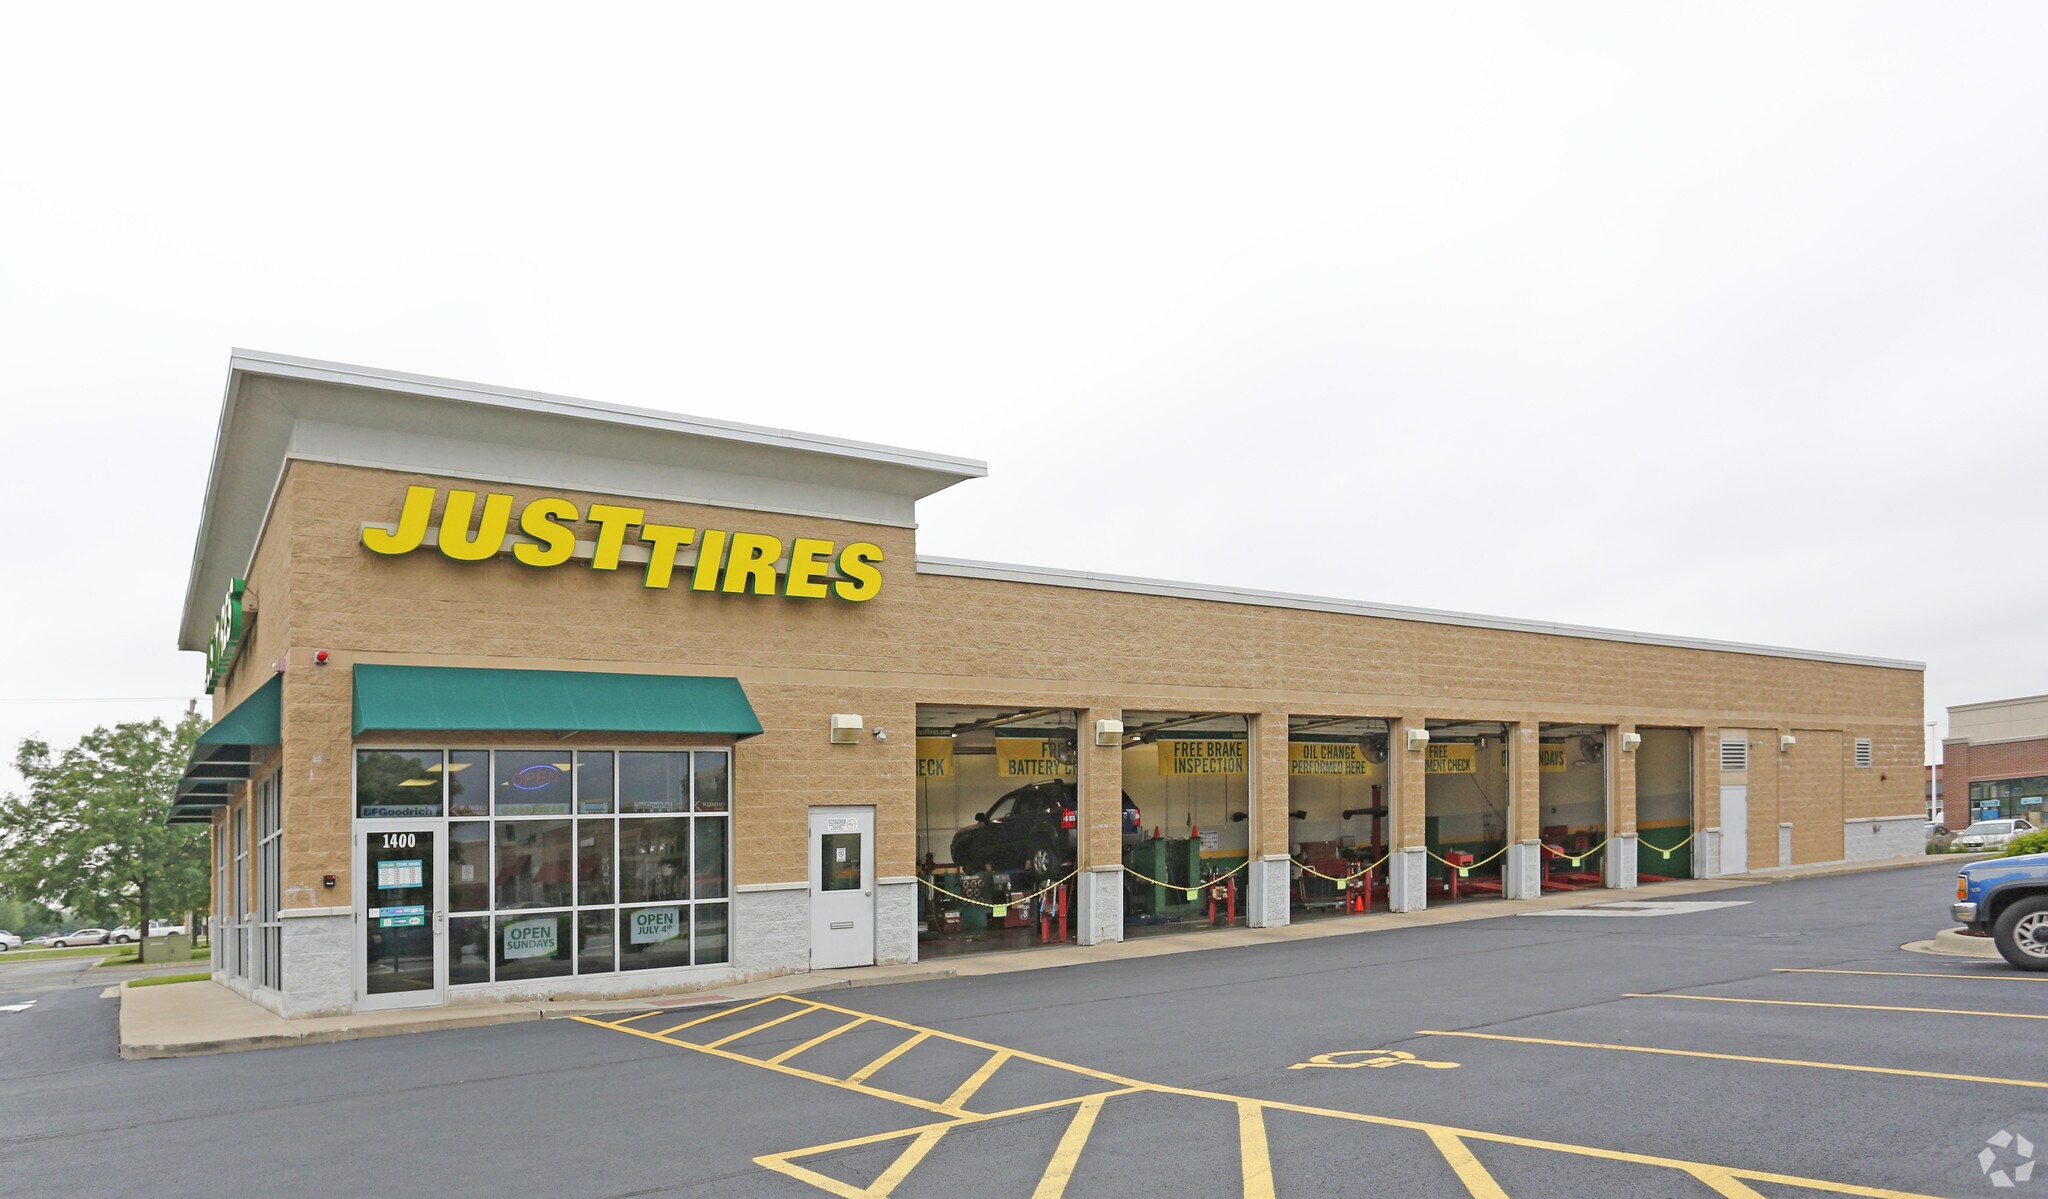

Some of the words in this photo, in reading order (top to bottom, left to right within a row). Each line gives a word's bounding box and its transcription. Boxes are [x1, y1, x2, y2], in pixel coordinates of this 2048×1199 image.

[361, 485, 646, 571] JUST
[641, 522, 885, 602] TIRES
[1174, 742, 1203, 757] FREE
[1207, 742, 1243, 757] BRAKE
[1303, 745, 1318, 759] OIL
[1321, 745, 1356, 759] CHANGE
[1429, 745, 1448, 758] FREE
[1009, 759, 1060, 775] BATTERY
[1174, 758, 1243, 773] INSPECTION
[1292, 760, 1343, 774] PERFORMED
[1346, 760, 1366, 774] HERE
[1425, 758, 1446, 772] MENT
[1447, 758, 1472, 772] CHECK
[511, 769, 559, 785] OPEN
[363, 807, 433, 816] BFGoodrich
[382, 833, 416, 848] 1400
[637, 913, 674, 926] OPEN
[511, 926, 551, 940] OPEN
[637, 926, 660, 935] JULY
[661, 924, 673, 933] 4th
[507, 938, 555, 950] SUNDAYS
